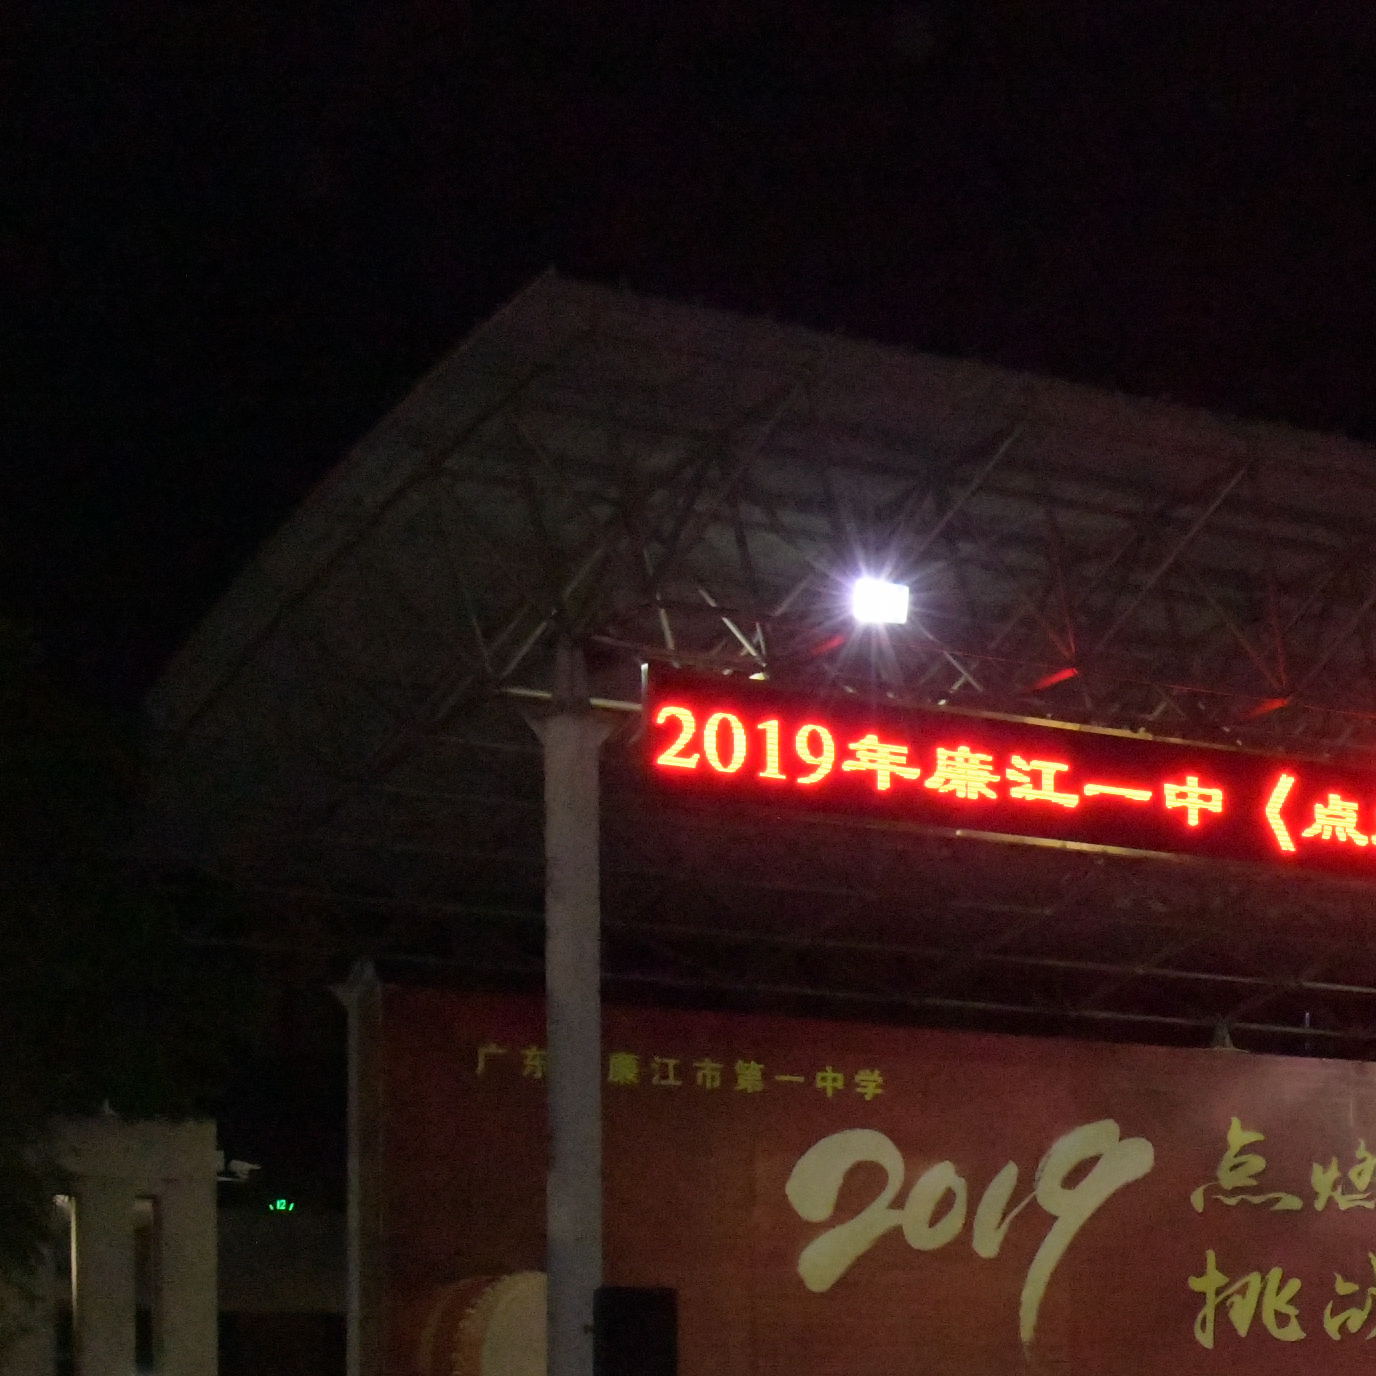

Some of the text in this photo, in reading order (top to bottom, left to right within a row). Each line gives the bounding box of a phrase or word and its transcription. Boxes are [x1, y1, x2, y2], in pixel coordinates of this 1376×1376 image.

[475, 1042, 884, 1101] 广东廉江市第一中学
[784, 1118, 1156, 1362] 2019
